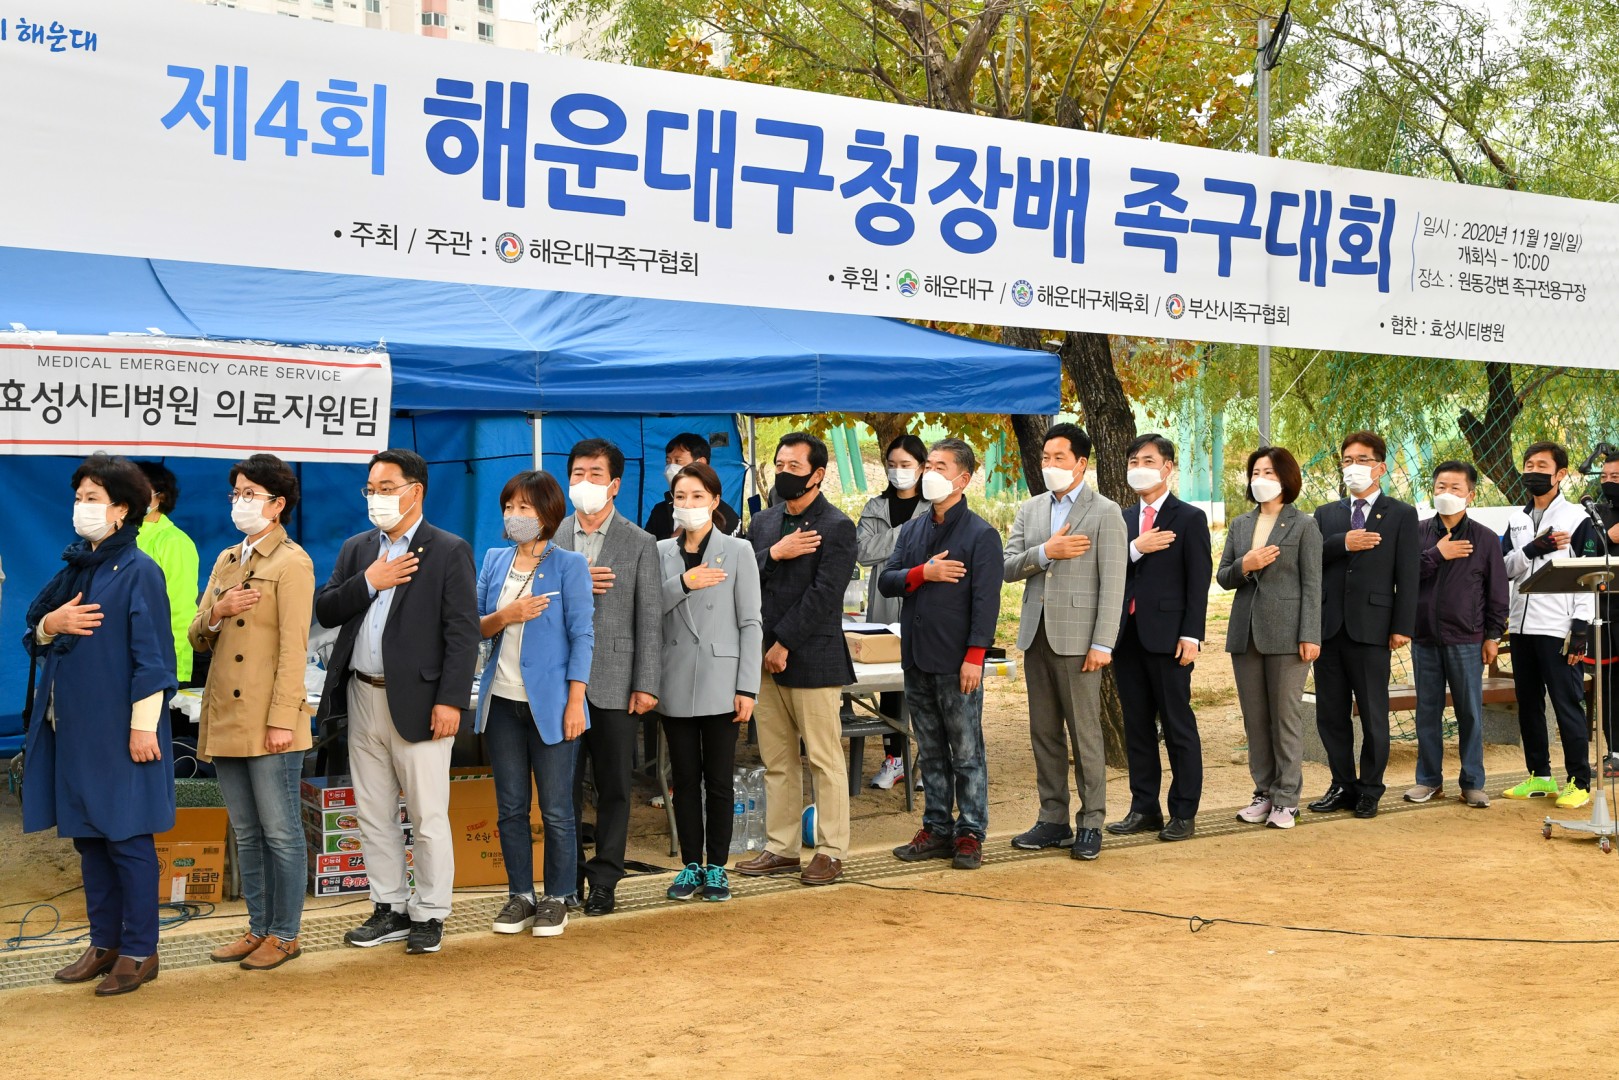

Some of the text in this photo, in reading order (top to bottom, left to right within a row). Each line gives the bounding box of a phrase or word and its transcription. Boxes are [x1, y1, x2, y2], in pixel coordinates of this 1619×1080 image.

[16, 18, 97, 52] 해운대
[161, 65, 1396, 294] 제4회 해운대구청장배 족구대회
[350, 222, 397, 250] 주최
[425, 229, 472, 256] 주관
[529, 239, 698, 276] 해운대구족구협회
[1424, 217, 1449, 238] 일시
[1462, 222, 1507, 245] 2020년
[1513, 229, 1539, 248] 11월
[1543, 232, 1583, 254] 1일(일)
[1458, 246, 1497, 267] 개회식
[1513, 253, 1549, 271] 10:00
[841, 267, 878, 291] 후원
[924, 275, 994, 301] 해운대구
[1037, 285, 1148, 314] 해운대구체육회
[1189, 298, 1289, 326] 부산시족구협회
[1418, 269, 1444, 288] 장소
[1458, 272, 1509, 295] 원동강변
[1513, 278, 1586, 302] 족구전용구장
[1391, 315, 1417, 335] 협찬
[1430, 320, 1504, 342] 효성시티병원
[38, 356, 342, 382] MEDICAL EMERGENCY CARE SERVICE
[0, 379, 378, 436] 효성시티병원 의료지원팀
[186, 872, 219, 883] 1등급란
